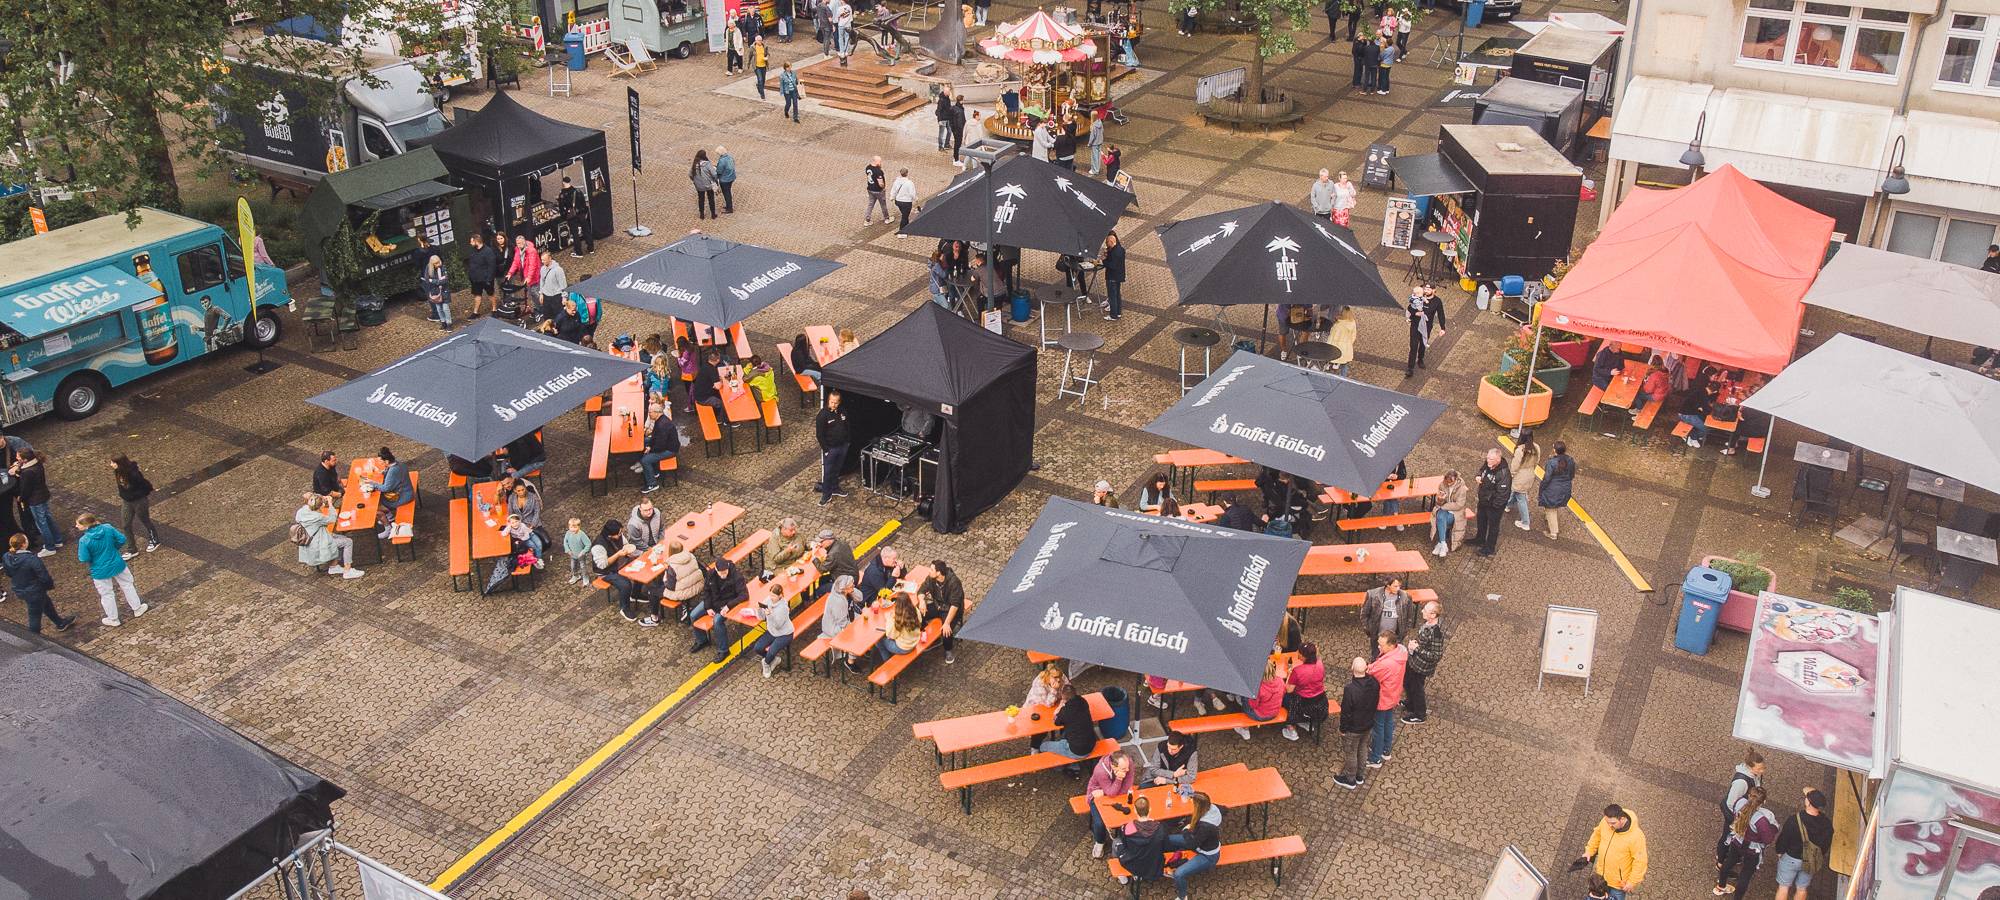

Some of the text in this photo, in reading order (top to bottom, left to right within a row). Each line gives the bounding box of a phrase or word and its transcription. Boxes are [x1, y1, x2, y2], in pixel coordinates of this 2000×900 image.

[13, 275, 109, 310] Gaffel
[631, 278, 702, 306] Gaffel Kölsch
[742, 261, 802, 293] Gaffel Kölsch
[44, 290, 120, 324] Wiess
[510, 366, 592, 412] Gaffel Kölsch
[383, 391, 458, 428] Gaffel Kölsch
[1363, 403, 1410, 448] Gaffel Kölsch
[1230, 422, 1327, 462] Gaffel Kölsch
[1227, 553, 1271, 622] Gaffel Kölsch
[1067, 611, 1189, 654] Gaffel Kölsch
[1803, 657, 1818, 686] Waffle
